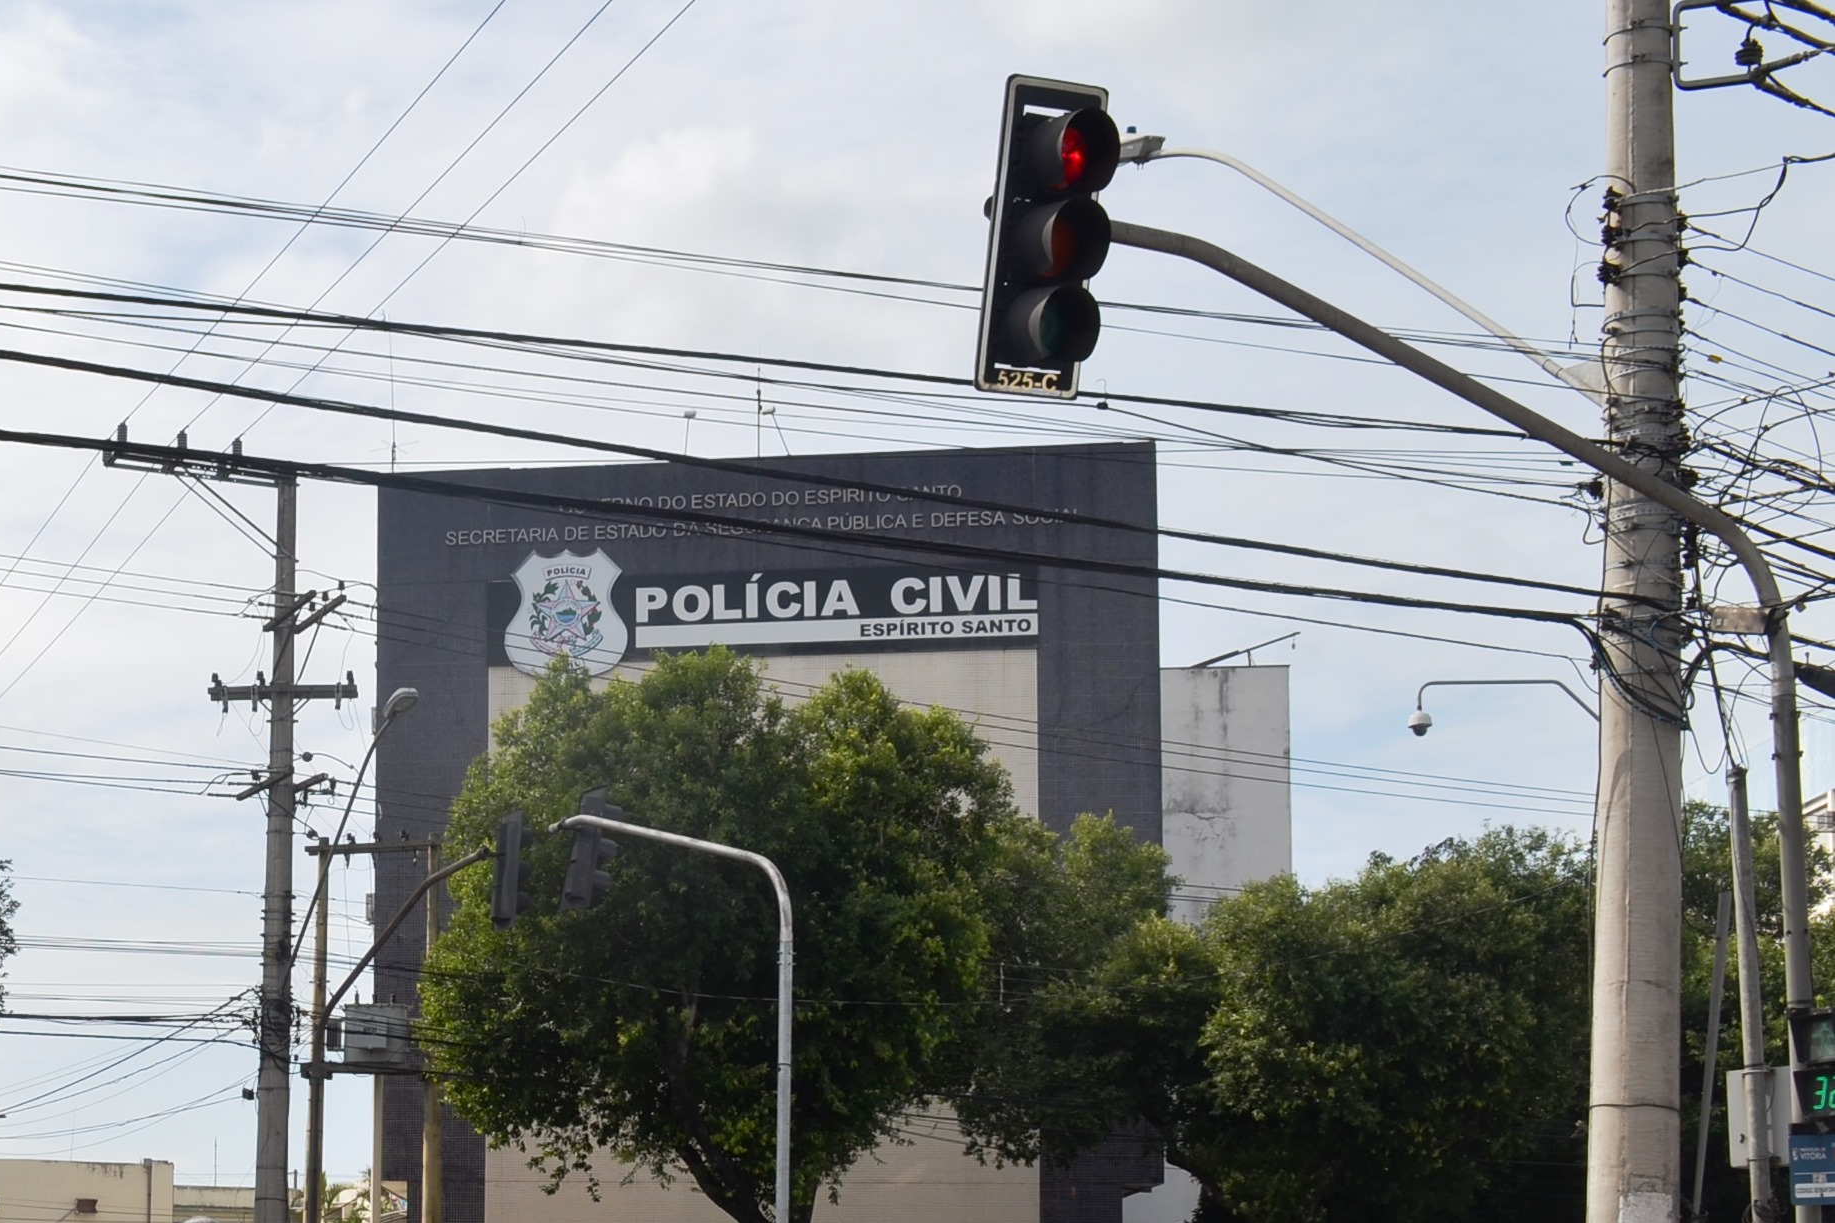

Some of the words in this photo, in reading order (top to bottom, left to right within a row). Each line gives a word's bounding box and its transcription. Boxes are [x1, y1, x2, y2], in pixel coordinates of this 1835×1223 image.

[996, 370, 1058, 392] 525-C
[658, 494, 687, 510] DO
[691, 491, 768, 509] ESTADO
[771, 490, 799, 507] DO
[445, 526, 559, 546] SECRETARIA
[565, 525, 590, 541] DE
[594, 522, 667, 541] ESTADO
[673, 521, 699, 538] DA
[827, 511, 907, 532] PÚBLICA
[912, 513, 924, 528] E
[931, 510, 1006, 527] DEFESA
[546, 566, 586, 577] POLÍCIA
[635, 572, 860, 623] POLÍCIA
[890, 573, 1038, 615] CIVIL
[859, 619, 955, 638] ESPÍRITO
[961, 618, 1032, 635] SANTO
